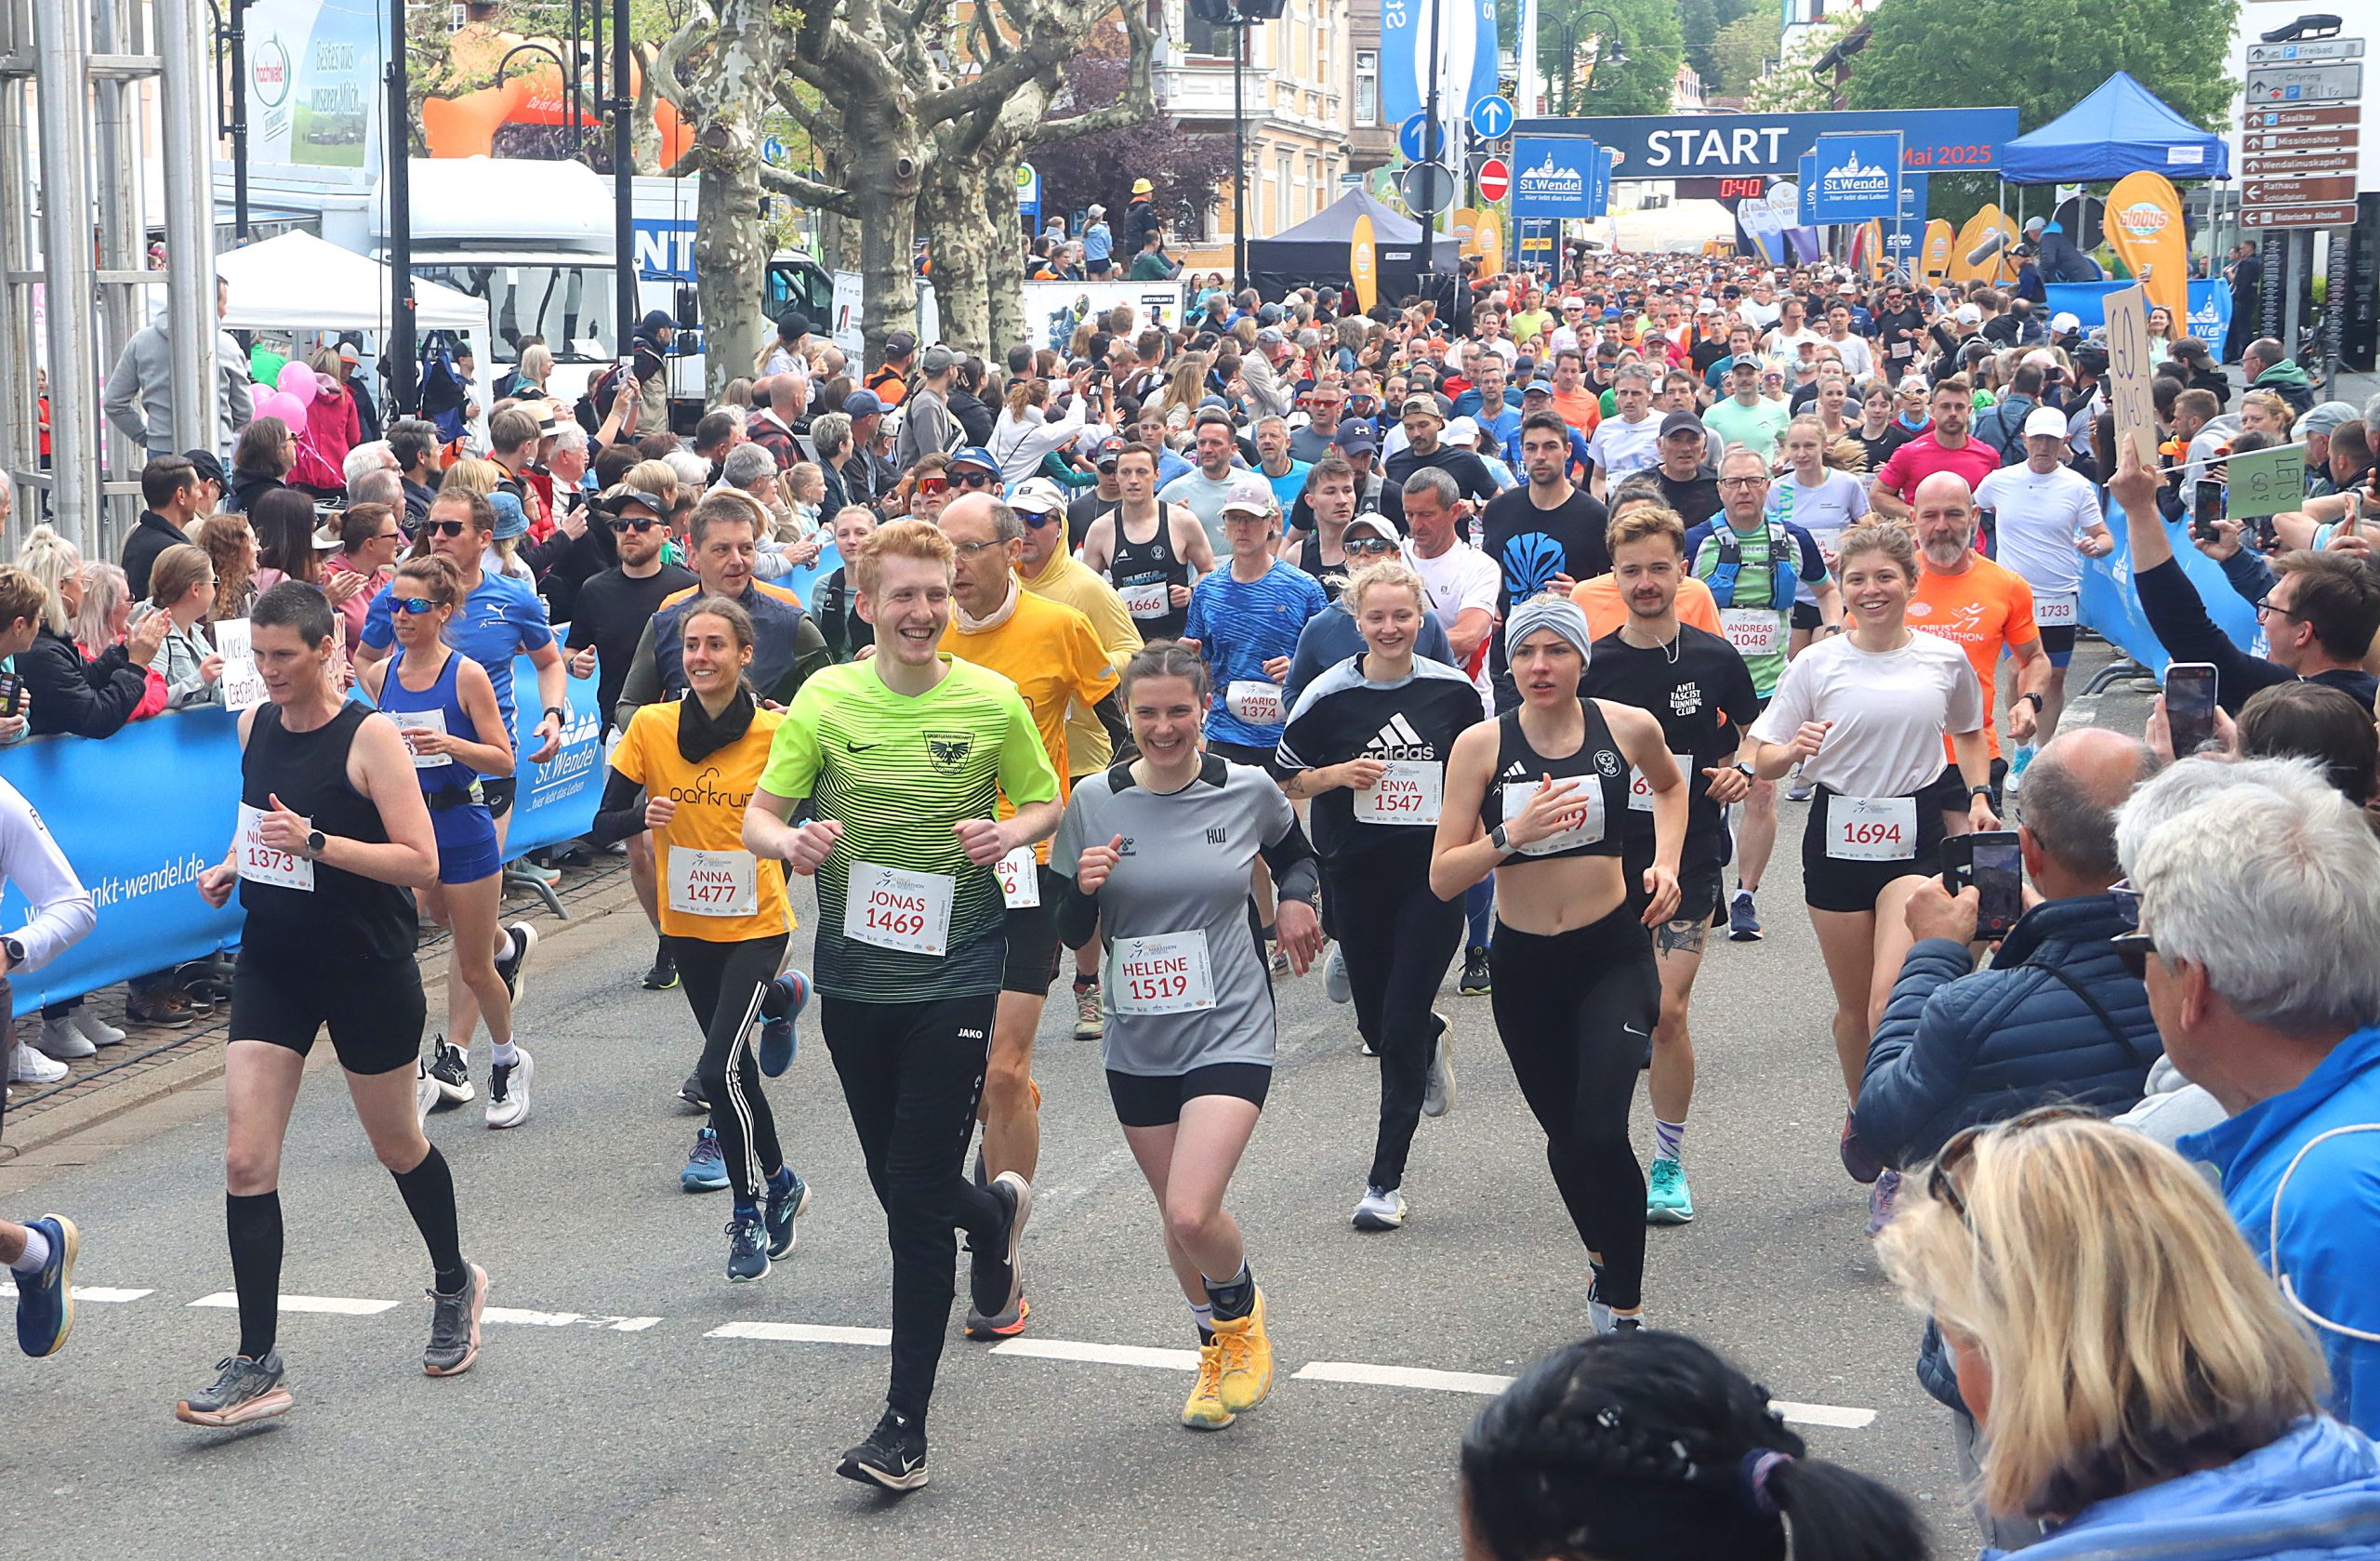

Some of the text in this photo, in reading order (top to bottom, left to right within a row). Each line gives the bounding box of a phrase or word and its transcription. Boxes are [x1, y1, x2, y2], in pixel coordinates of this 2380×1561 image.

[2298, 46, 2333, 55] Freibad
[2286, 73, 2321, 82] Cityring
[2280, 113, 2316, 123] Saalbau
[1646, 126, 1790, 167] START
[2278, 135, 2340, 145] Missionshaus
[1937, 144, 1992, 165] 2025
[2262, 157, 2347, 169] Wendalinuskapelle
[1721, 179, 1763, 198] 0:40
[2263, 182, 2301, 191] Rathaus
[2275, 211, 2342, 221] Historische Altstadt
[2275, 457, 2300, 500] LET'S
[1127, 598, 1160, 612] 1666
[2040, 604, 2069, 617] 1733
[1727, 623, 1773, 633] ANDREAS
[1733, 633, 1767, 646] 1048
[1676, 681, 1696, 693] ANTI
[1241, 695, 1277, 707] MARIO
[1671, 689, 1700, 701] FASCIST
[1670, 697, 1702, 709] RUNNING
[1241, 706, 1276, 719] 1374
[1676, 706, 1696, 717] CLUB
[1359, 744, 1435, 761] adidas
[1381, 780, 1418, 792] ENYA
[1375, 794, 1423, 812] 1547
[1844, 822, 1901, 844] 1694
[248, 847, 294, 872] 1373
[690, 869, 733, 883] ANNA
[687, 883, 736, 903] 1477
[868, 890, 926, 912] JONAS
[866, 907, 924, 936] 1469
[1122, 957, 1188, 976] HELENE
[1130, 975, 1187, 999] 1519
[958, 1027, 983, 1039] JAKO
